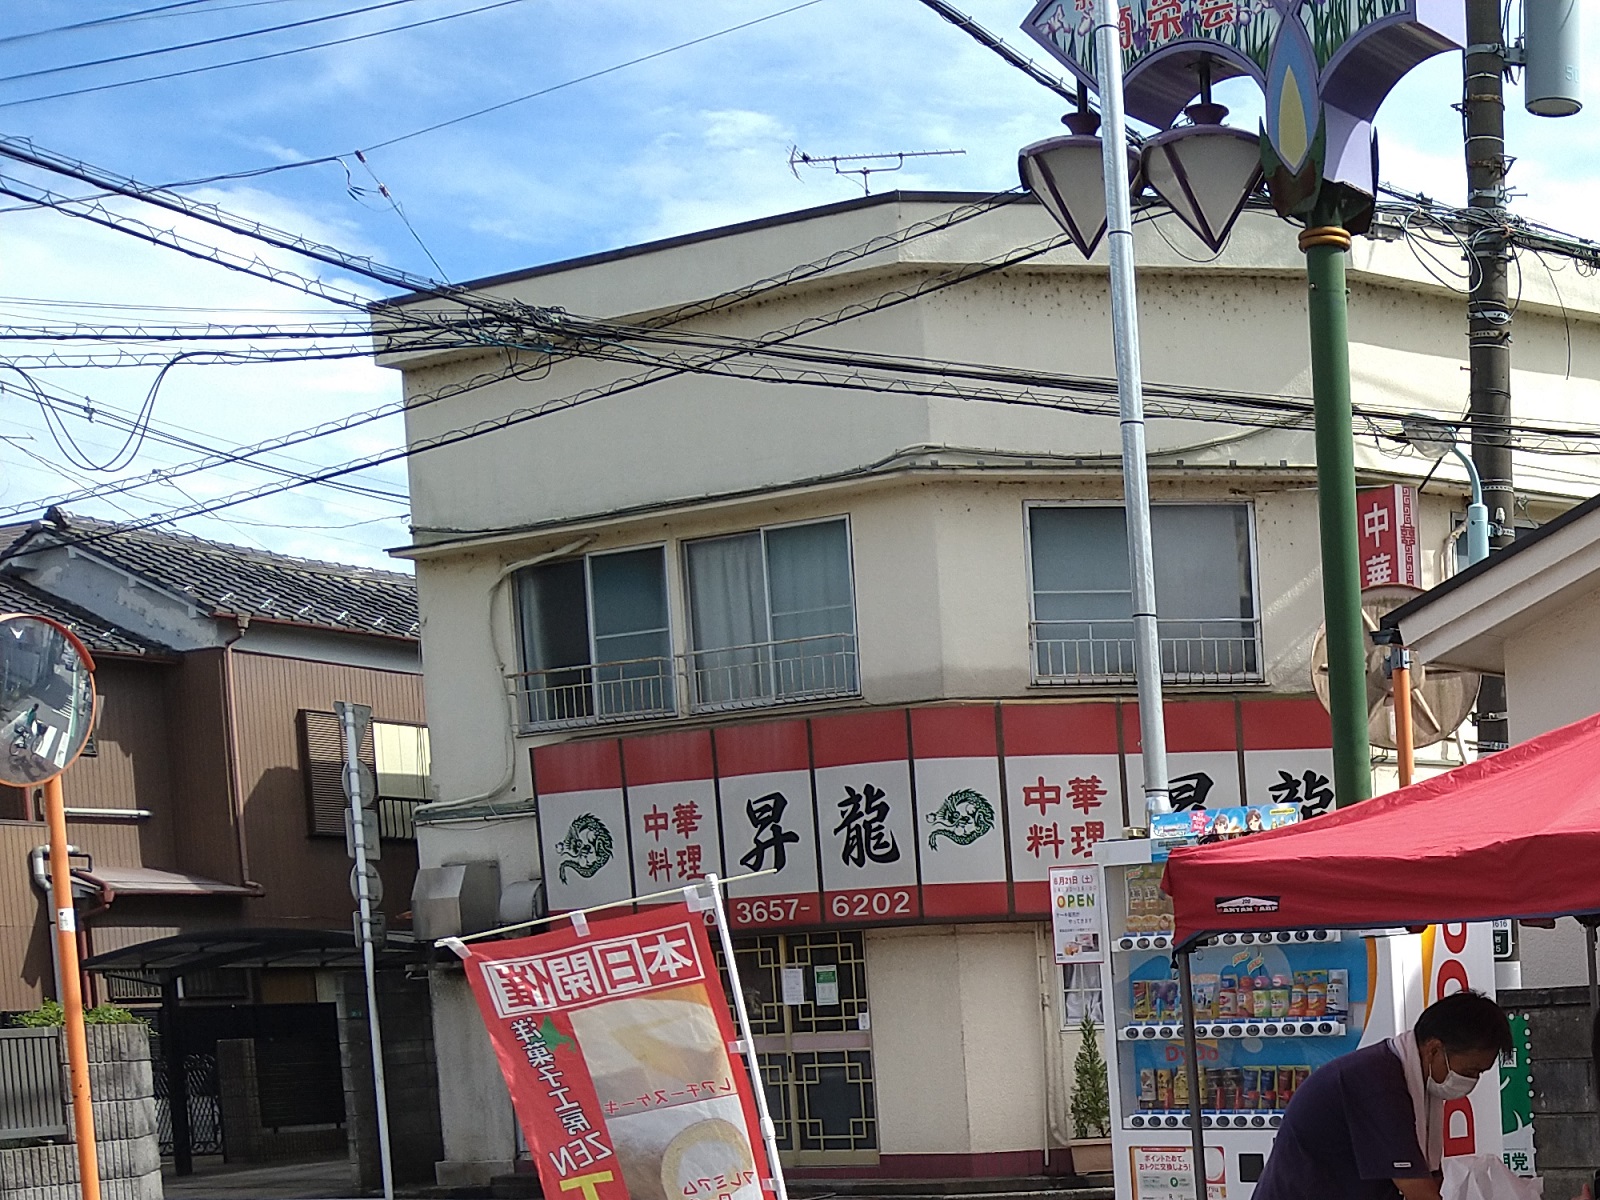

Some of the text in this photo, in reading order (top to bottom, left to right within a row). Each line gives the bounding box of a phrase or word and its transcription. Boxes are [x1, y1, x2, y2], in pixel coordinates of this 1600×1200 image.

[1363, 502, 1392, 586] 中華
[1022, 775, 1108, 816] 中華
[643, 800, 703, 842] 中華
[1026, 820, 1105, 859] 料理
[647, 844, 707, 883] 料理
[1057, 893, 1095, 909] OPEN
